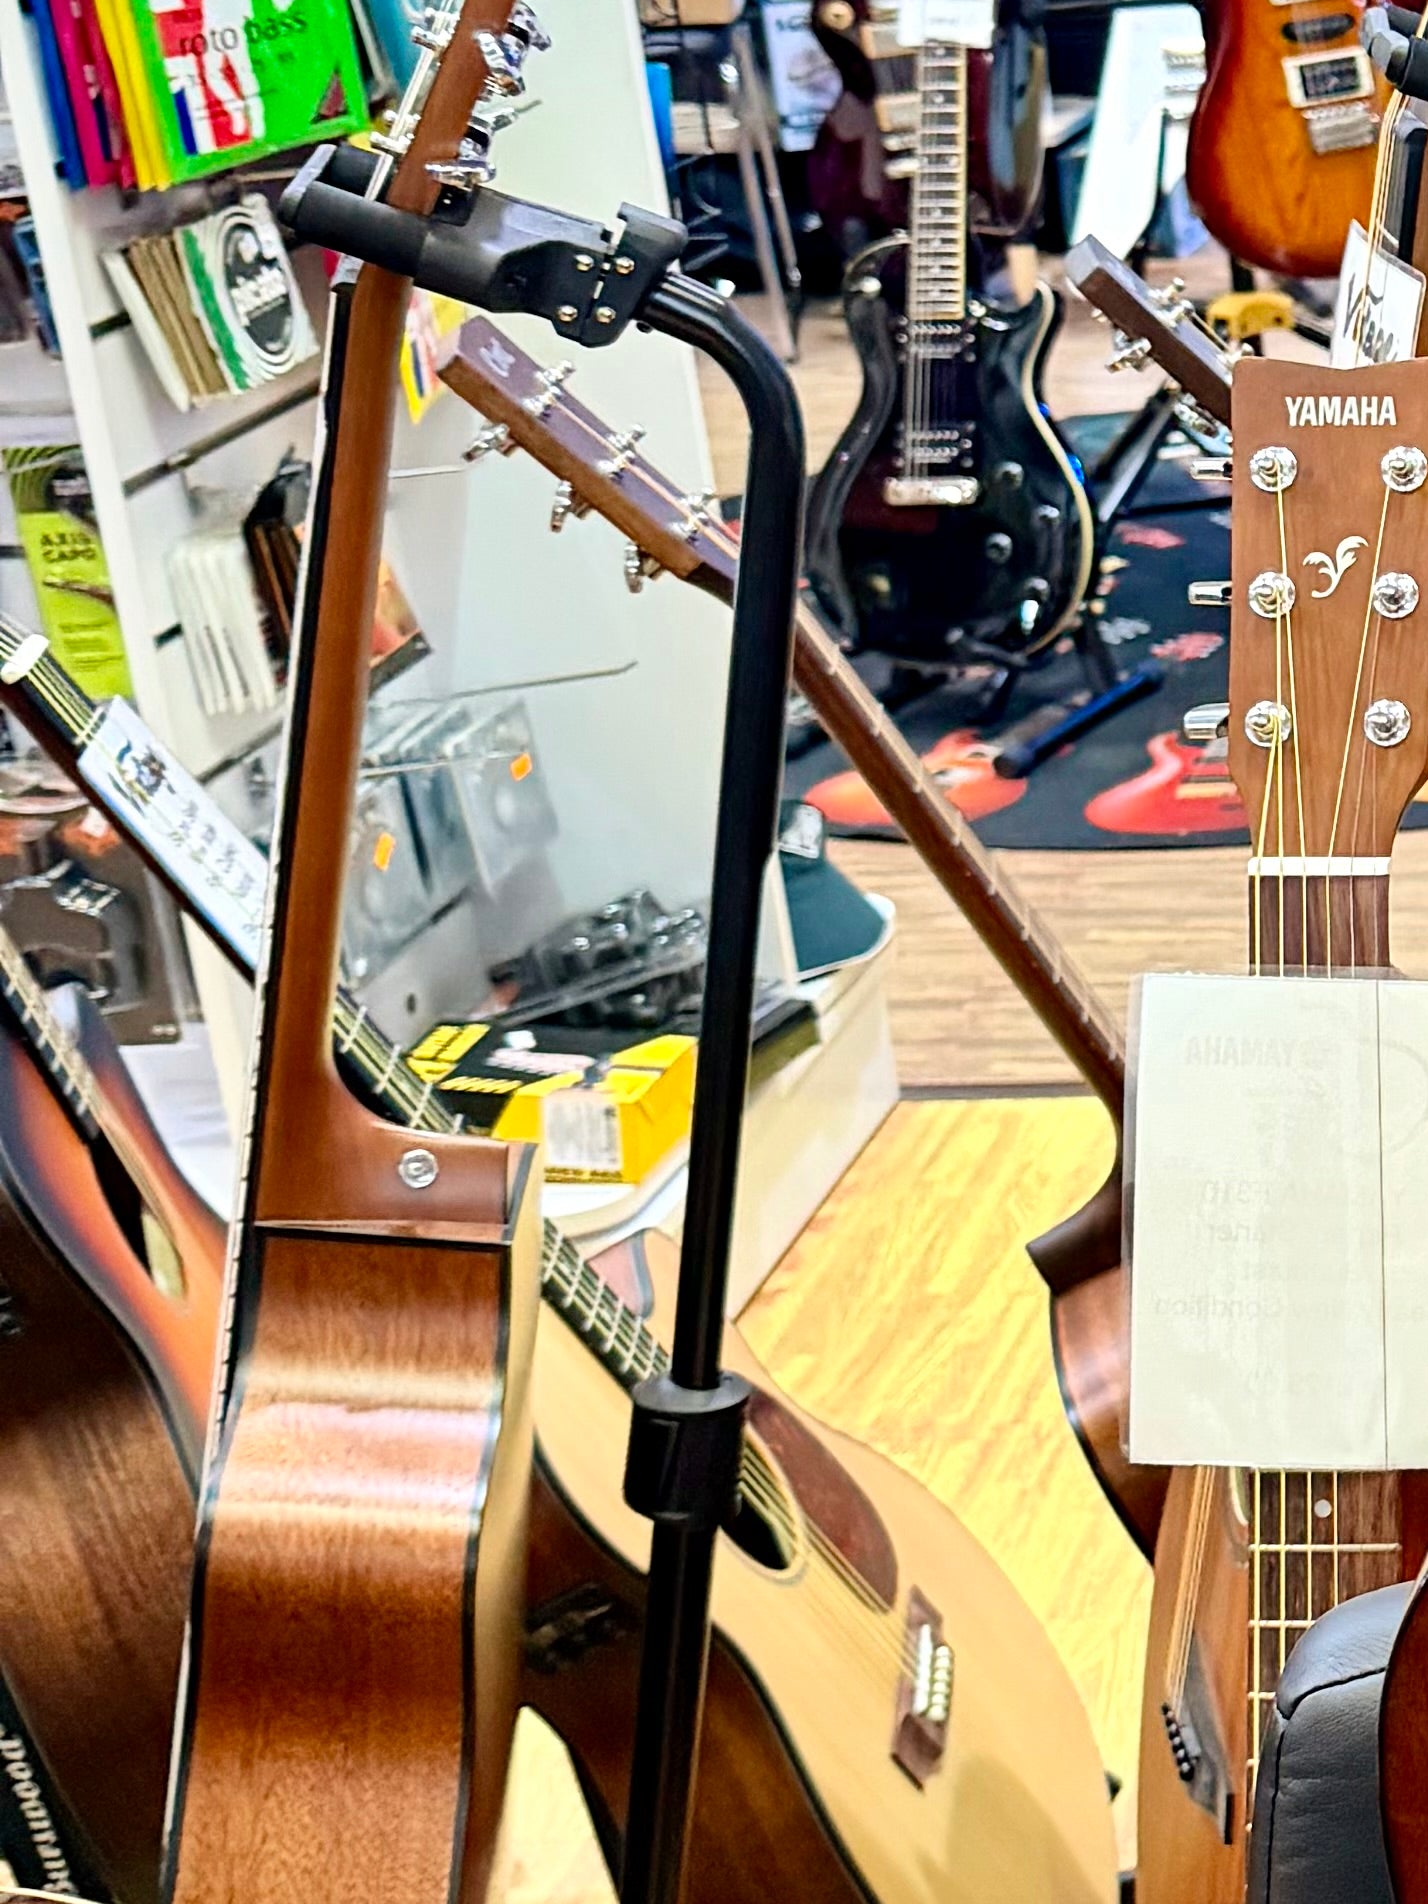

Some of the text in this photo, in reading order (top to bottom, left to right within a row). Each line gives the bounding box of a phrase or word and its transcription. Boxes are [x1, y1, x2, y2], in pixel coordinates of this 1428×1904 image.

[179, 12, 309, 57] roto bass
[1285, 395, 1397, 427] YAMAHA
